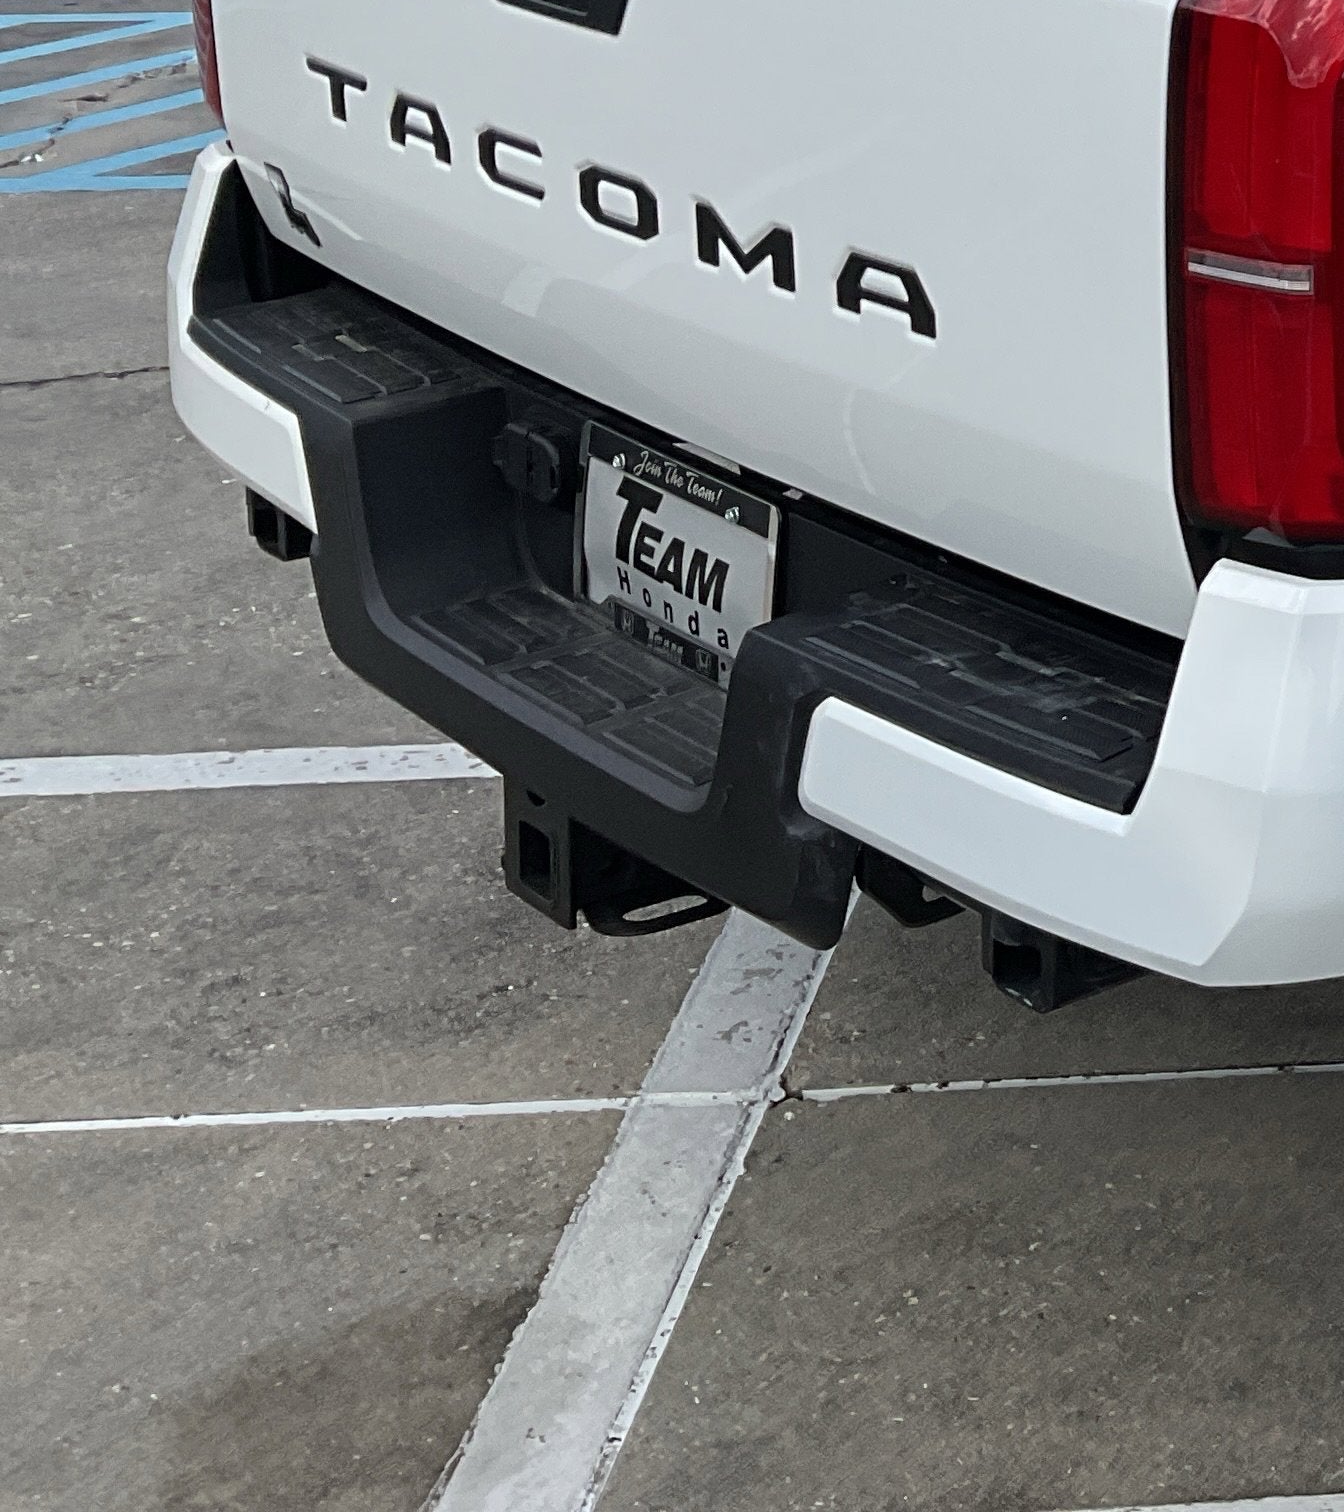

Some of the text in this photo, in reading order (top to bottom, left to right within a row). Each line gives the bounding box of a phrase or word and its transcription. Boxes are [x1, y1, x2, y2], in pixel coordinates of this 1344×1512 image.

[305, 56, 937, 339] TACOMA
[633, 450, 723, 506] Join The Team!
[616, 476, 730, 613] TEAM
[616, 566, 730, 649] Honda
